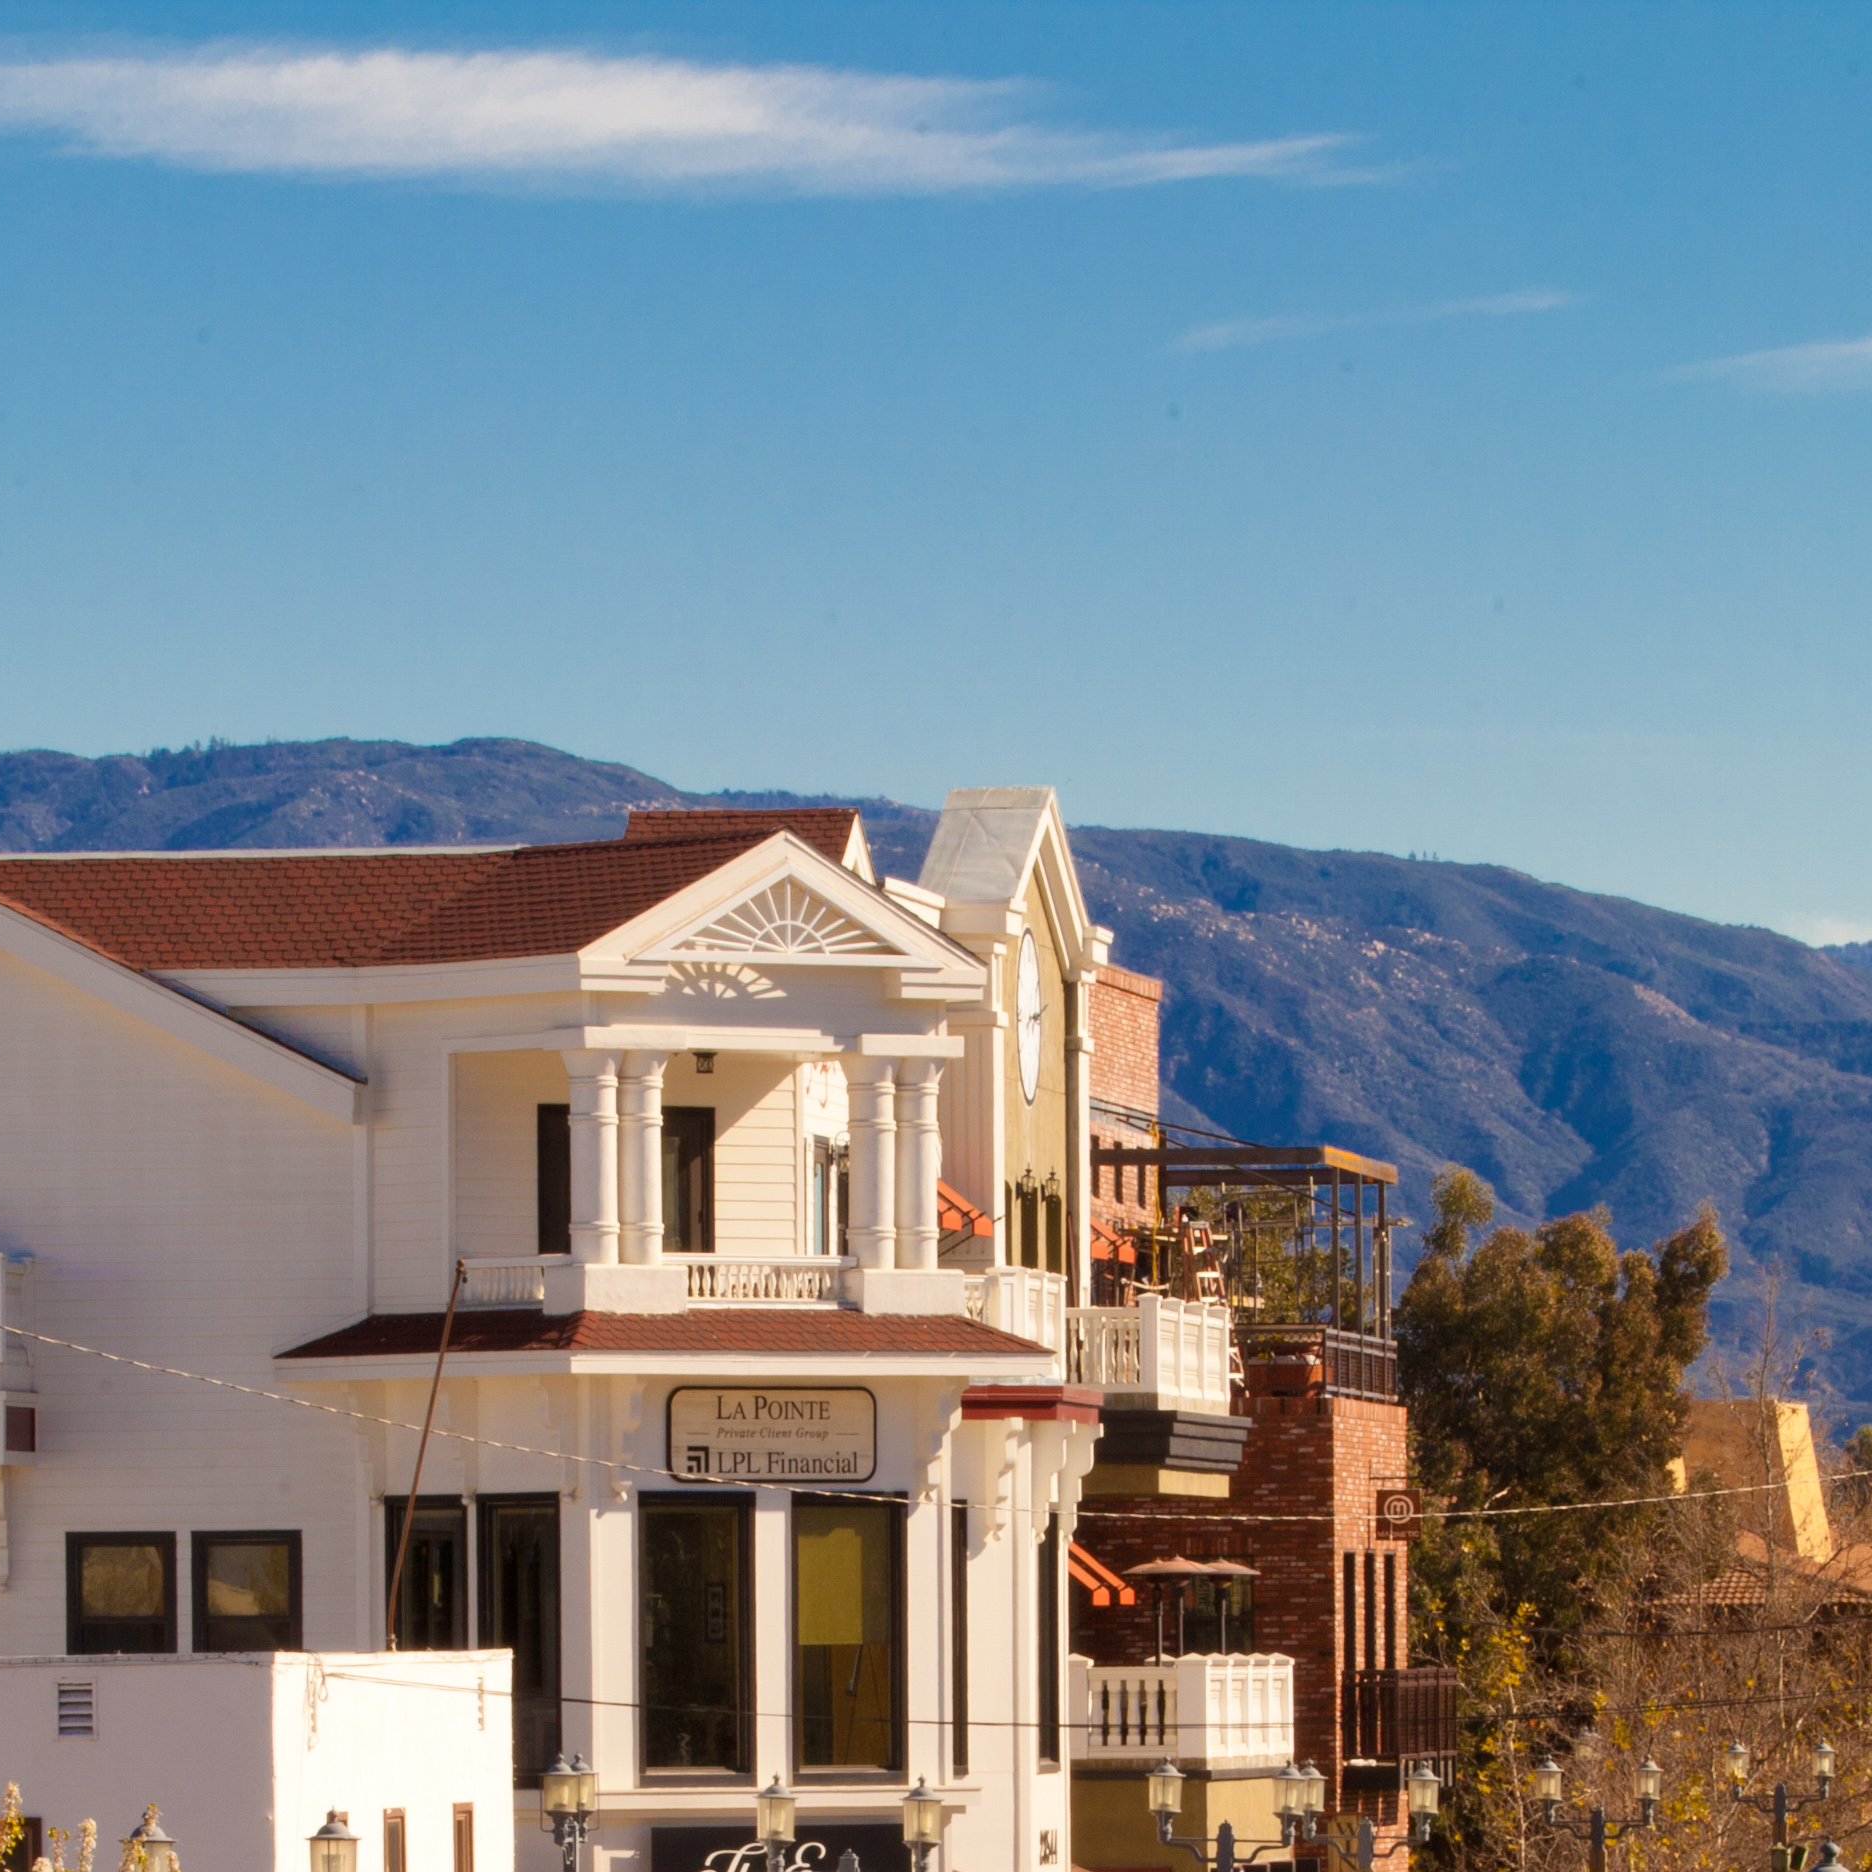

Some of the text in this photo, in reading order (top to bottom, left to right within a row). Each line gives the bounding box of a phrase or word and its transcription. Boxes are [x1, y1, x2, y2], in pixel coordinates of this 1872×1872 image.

[753, 1395, 831, 1420] POINTE
[716, 1427, 829, 1441] Private Client Group
[717, 1451, 858, 1474] LPL Financial
